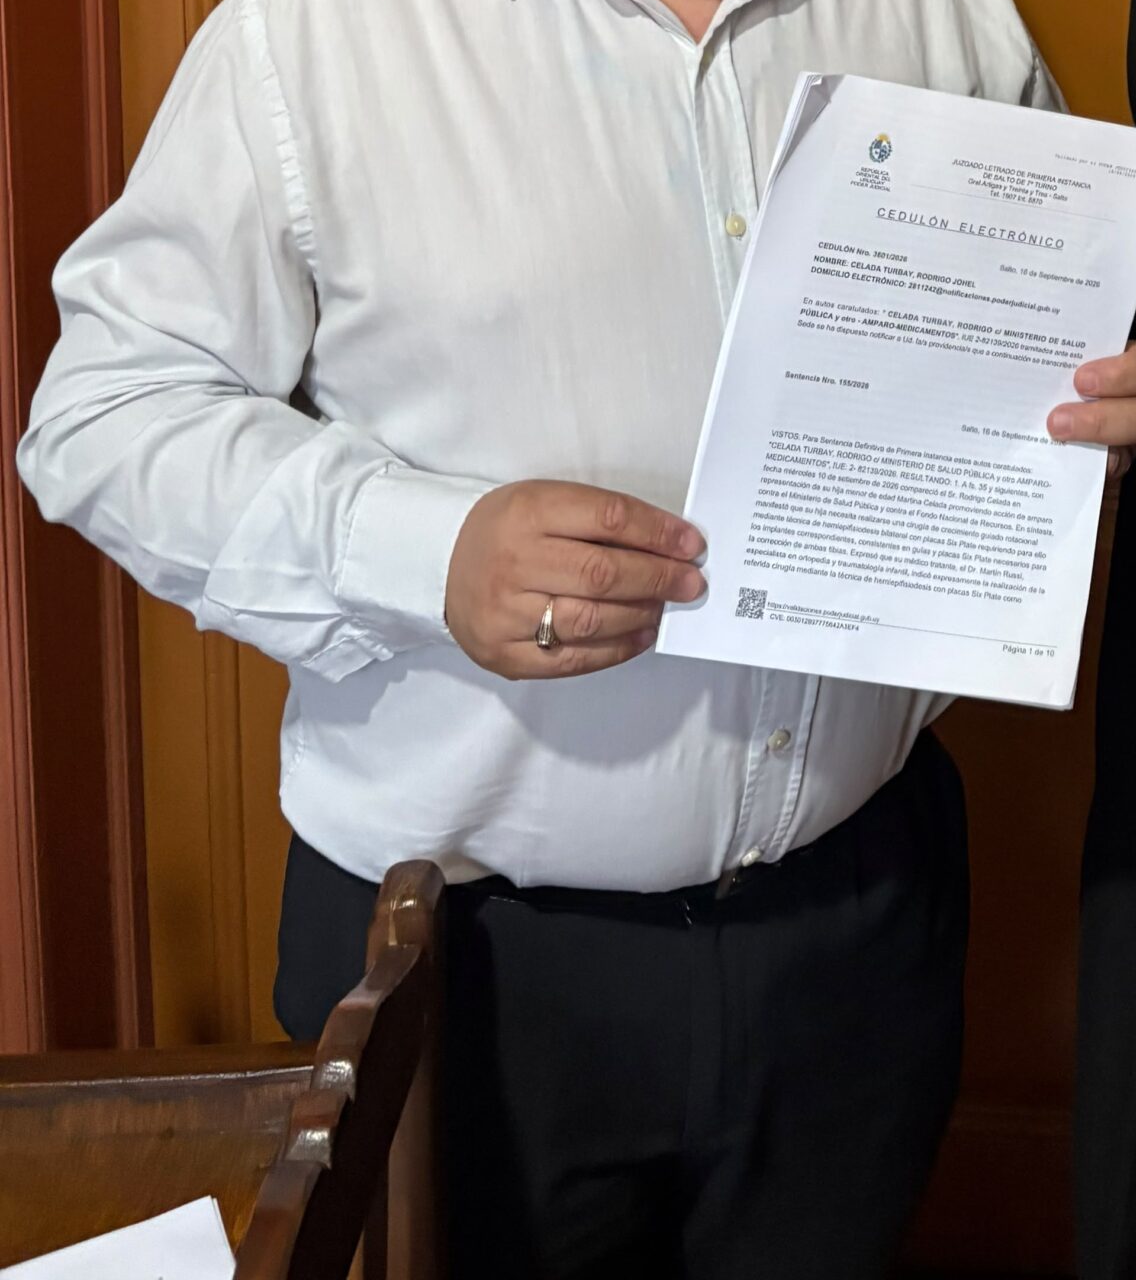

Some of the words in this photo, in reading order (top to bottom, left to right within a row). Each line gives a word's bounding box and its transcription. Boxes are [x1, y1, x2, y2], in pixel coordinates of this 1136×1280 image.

[951, 158, 984, 169] JUZGADO
[983, 164, 1016, 175] LETRADO
[1025, 172, 1056, 183] PRIMERA
[1056, 178, 1091, 189] INSTANCIA
[982, 171, 993, 179] DE
[992, 173, 1016, 183] SALTO
[1015, 177, 1025, 185] DE
[1034, 181, 1058, 191] TURNO
[875, 208, 949, 227] CEDULÓN
[958, 222, 1065, 247] ELECTRÓNICO
[817, 241, 855, 254] CEDULÓN
[855, 247, 870, 256] Nro.
[809, 265, 851, 278] DOMICILIO
[850, 272, 907, 288] ELECTRÓNICO:
[812, 254, 849, 266] NOMBRE:
[849, 260, 882, 272] CELADA
[915, 271, 952, 284] RODRIGO
[1027, 269, 1038, 277] de
[1037, 271, 1074, 283] Septiembre
[1074, 277, 1084, 285] de
[799, 307, 834, 319] PÚBLICA
[1053, 349, 1069, 357] ante
[802, 296, 813, 305] En
[814, 300, 835, 308] autos
[886, 310, 920, 322] CELADA
[956, 321, 993, 333] RODRIGO
[1002, 328, 1047, 342] MINISTERIO
[1047, 336, 1059, 344] DE
[1060, 338, 1086, 348] SALUD
[835, 325, 868, 337] dispuesto
[868, 331, 895, 341] notificar
[990, 351, 1031, 363] continuación
[784, 370, 820, 382] Sentencia
[821, 375, 836, 384] Nro.
[801, 433, 819, 442] Para
[819, 436, 853, 447] Sentencia
[895, 447, 922, 458] Primera
[835, 450, 873, 462] RODRIGO
[879, 456, 925, 470] MINISTERIO
[924, 463, 936, 471] DE
[936, 465, 963, 475] SALUD
[962, 468, 996, 480] PÚBLICA
[762, 463, 782, 473] fecha
[958, 492, 985, 504] Rodrigo
[985, 496, 1011, 506] Celada
[898, 471, 952, 486] RESULTANDO:
[759, 476, 811, 489] representación
[830, 485, 844, 495] hija
[844, 489, 867, 497] menor
[895, 495, 922, 505] Martina
[922, 499, 947, 509] Celada
[947, 504, 992, 516] promoviendo
[752, 512, 785, 522] mediante
[785, 515, 811, 525] técnica
[757, 488, 780, 497] contra
[787, 491, 822, 503] Ministerio
[832, 497, 853, 507] Salud
[852, 500, 879, 511] Pública
[915, 510, 938, 520] Fondo
[938, 513, 969, 524] Nacional
[978, 519, 1013, 531] Recursos.
[827, 510, 857, 520] necesita
[856, 515, 891, 525] realizarse
[761, 524, 796, 535] implantes
[795, 530, 857, 546] correspondientes,
[745, 547, 787, 559] especialista
[797, 554, 831, 565] ortopedia
[836, 559, 884, 573] traumatología
[849, 548, 879, 559] Expresó
[770, 562, 795, 573] cirugía
[1001, 643, 1027, 654] Página
[1028, 647, 1033, 655] 1
[1033, 648, 1044, 656] de
[1045, 649, 1055, 658] 10
